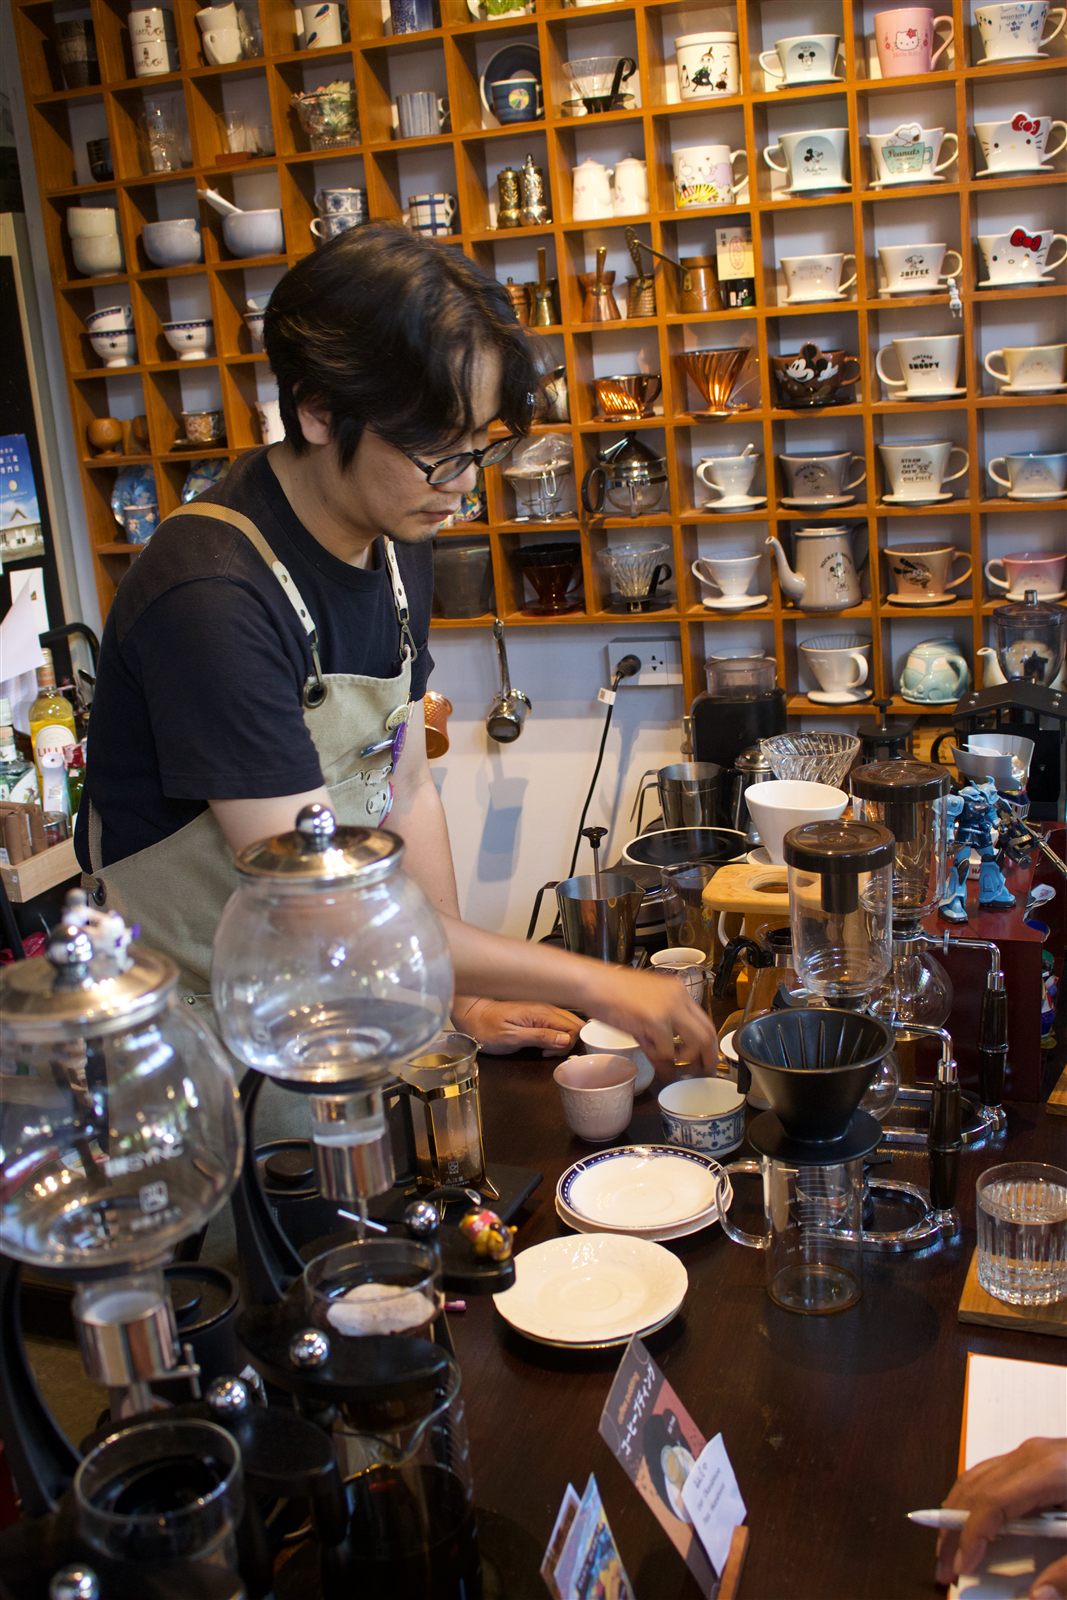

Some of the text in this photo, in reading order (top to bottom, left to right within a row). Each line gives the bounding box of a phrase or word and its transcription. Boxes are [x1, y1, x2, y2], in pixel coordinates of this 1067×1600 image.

[888, 148, 920, 158] Peanuts
[900, 268, 929, 277] COFFEE
[909, 362, 939, 370] SNOOPY
